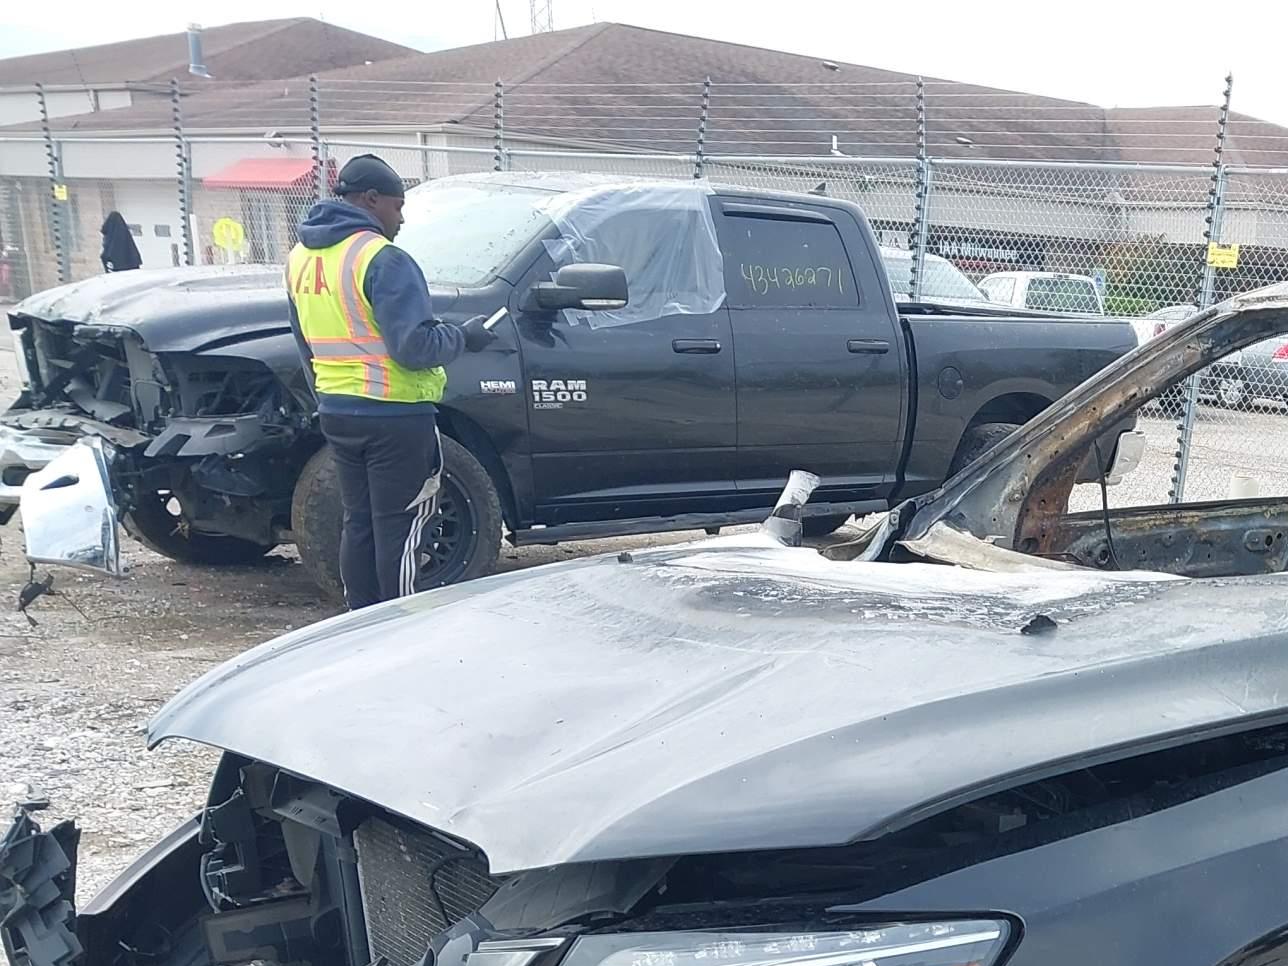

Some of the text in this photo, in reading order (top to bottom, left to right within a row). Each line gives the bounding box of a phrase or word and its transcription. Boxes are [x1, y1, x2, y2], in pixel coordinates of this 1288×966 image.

[740, 263, 843, 295] 43426271
[480, 380, 516, 389] HEMI
[532, 380, 587, 391] RAM
[533, 391, 587, 402] 1500
